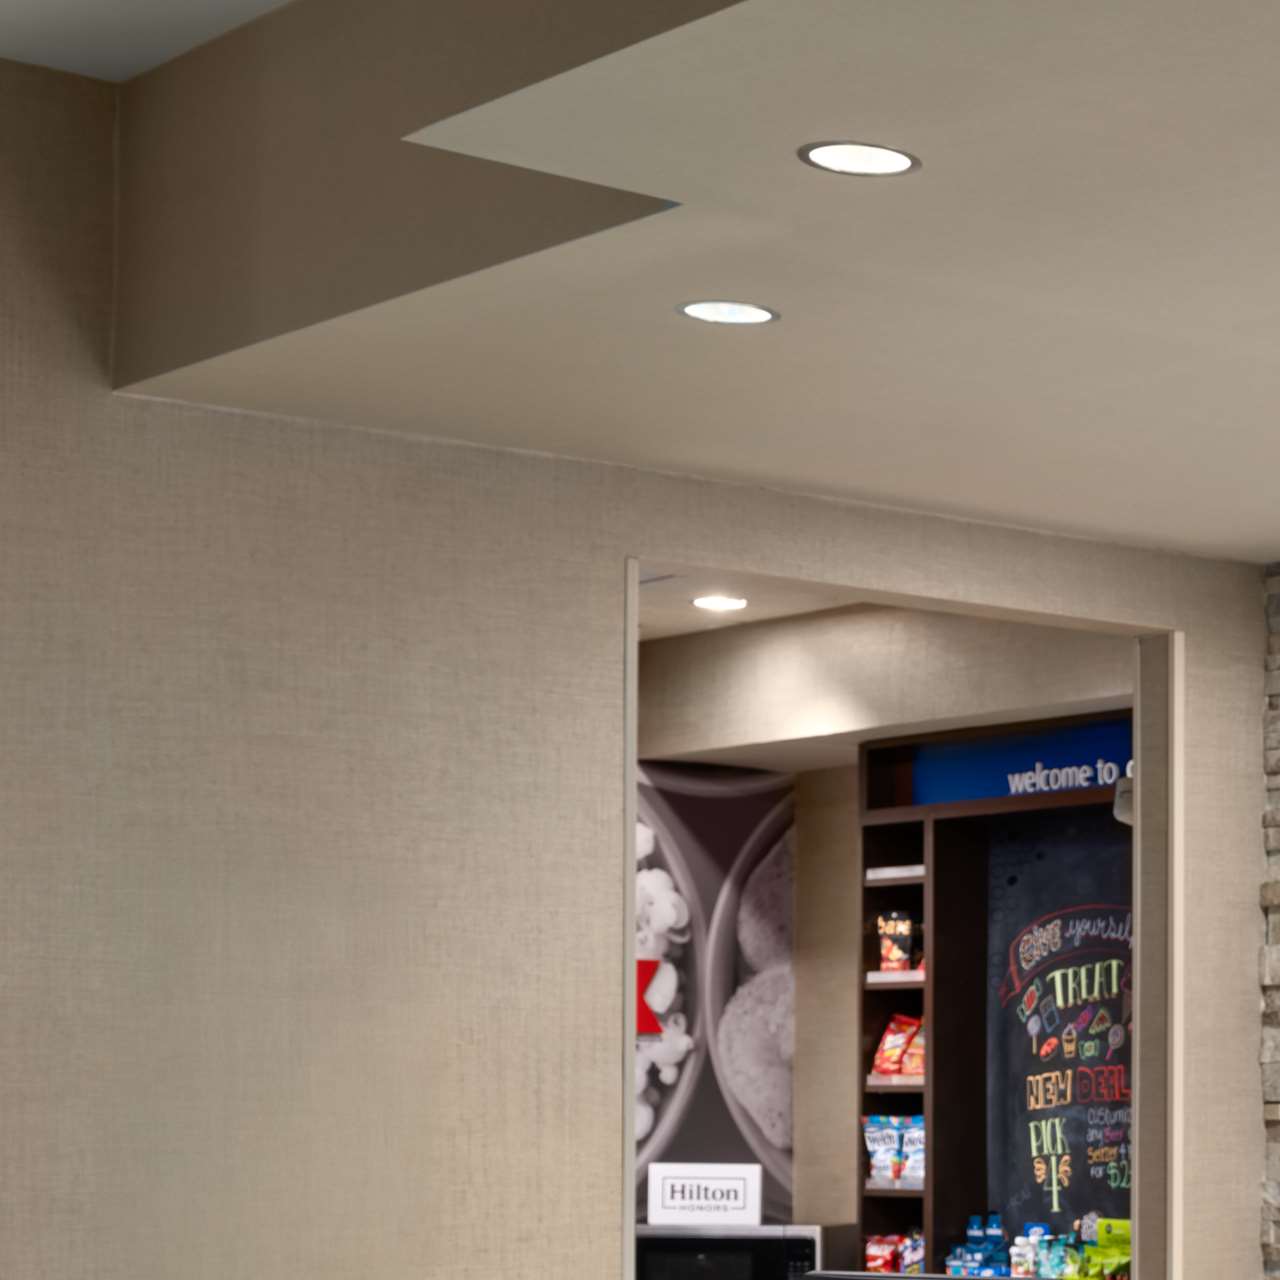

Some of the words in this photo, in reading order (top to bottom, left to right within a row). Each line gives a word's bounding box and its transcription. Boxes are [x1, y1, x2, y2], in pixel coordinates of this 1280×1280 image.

[1007, 761, 1091, 794] welcome
[1096, 758, 1119, 784] to
[1046, 959, 1125, 1010] TREAT
[1026, 1068, 1073, 1111] NEW
[1028, 1117, 1070, 1157] PICK
[670, 1184, 738, 1201] Hilton
